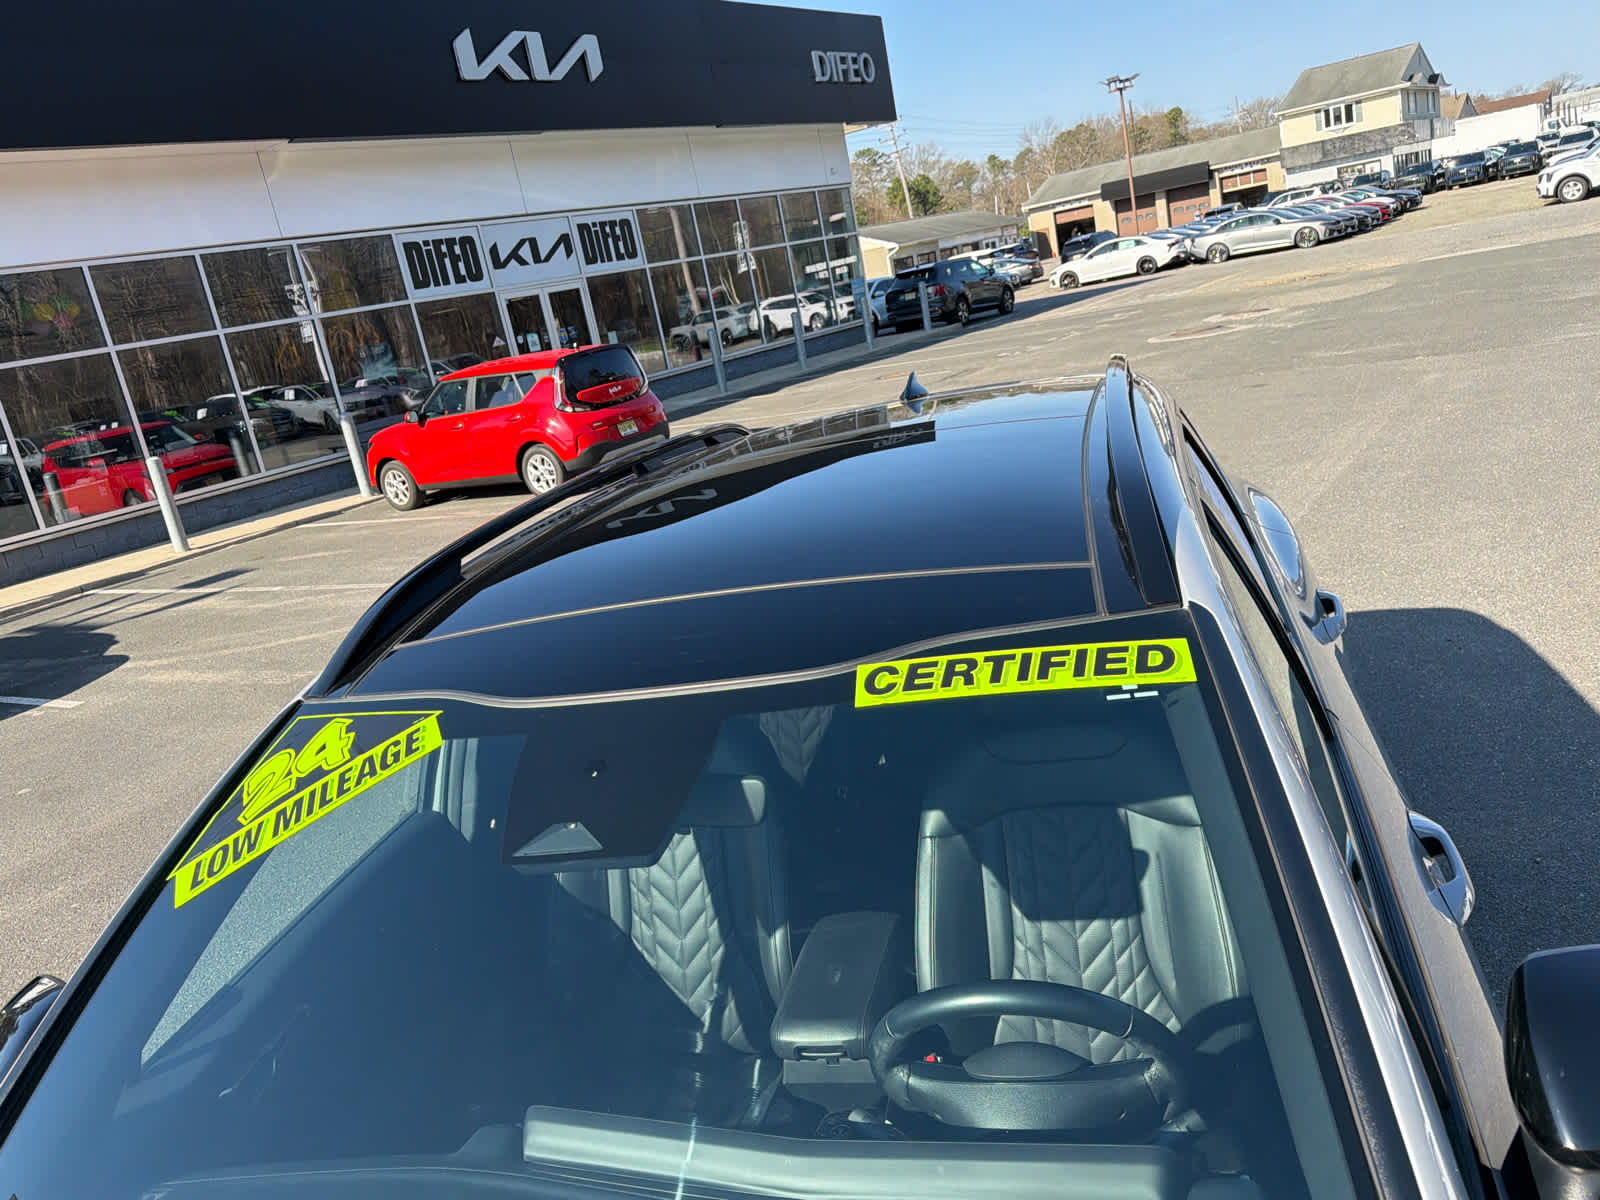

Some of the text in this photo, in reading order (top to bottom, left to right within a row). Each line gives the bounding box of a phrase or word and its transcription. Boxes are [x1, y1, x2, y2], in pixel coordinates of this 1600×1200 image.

[452, 27, 604, 82] KIA
[863, 644, 1177, 697] CERTIFIED
[190, 724, 427, 893] LOW MILEAGE
[237, 718, 355, 825] 24
